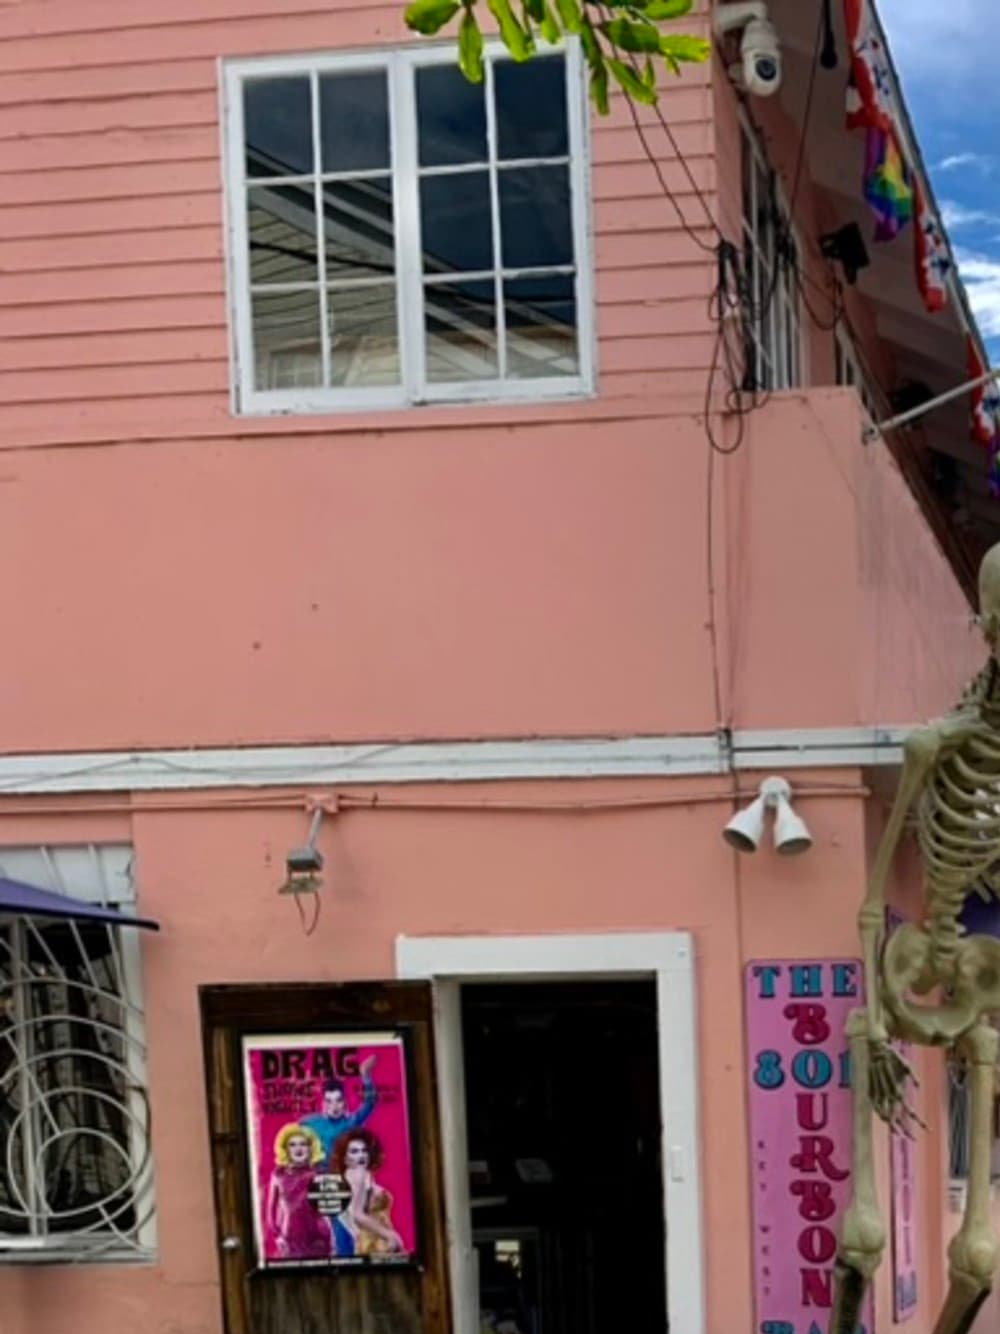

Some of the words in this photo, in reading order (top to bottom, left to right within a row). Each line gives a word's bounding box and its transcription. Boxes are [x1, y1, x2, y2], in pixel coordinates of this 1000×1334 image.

[752, 964, 857, 998] THE
[261, 1048, 360, 1079] DRAG
[783, 1003, 851, 1308] BOURBON
